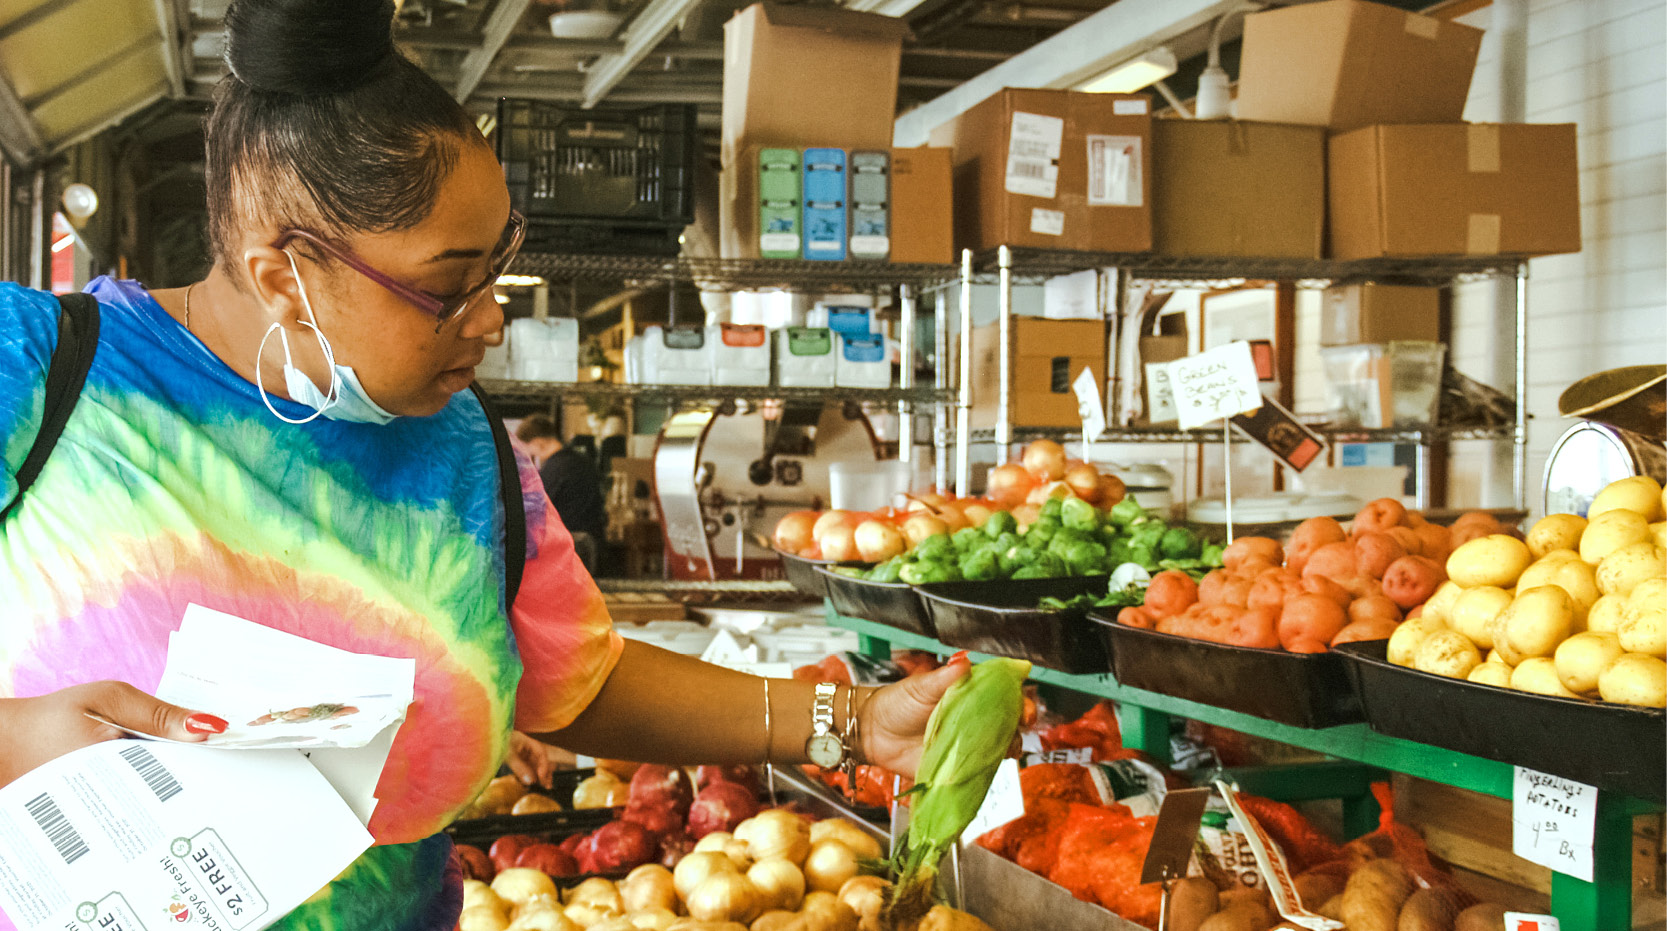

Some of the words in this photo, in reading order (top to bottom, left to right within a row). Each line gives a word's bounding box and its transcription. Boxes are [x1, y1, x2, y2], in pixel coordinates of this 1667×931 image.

[1178, 360, 1227, 383] GREEN
[1184, 376, 1237, 398] BEANS
[160, 856, 191, 894] Fresh!
[192, 848, 232, 895] FREE
[1234, 832, 1258, 887] AHO
[190, 894, 221, 931] uckeye
[227, 894, 242, 915] $2
